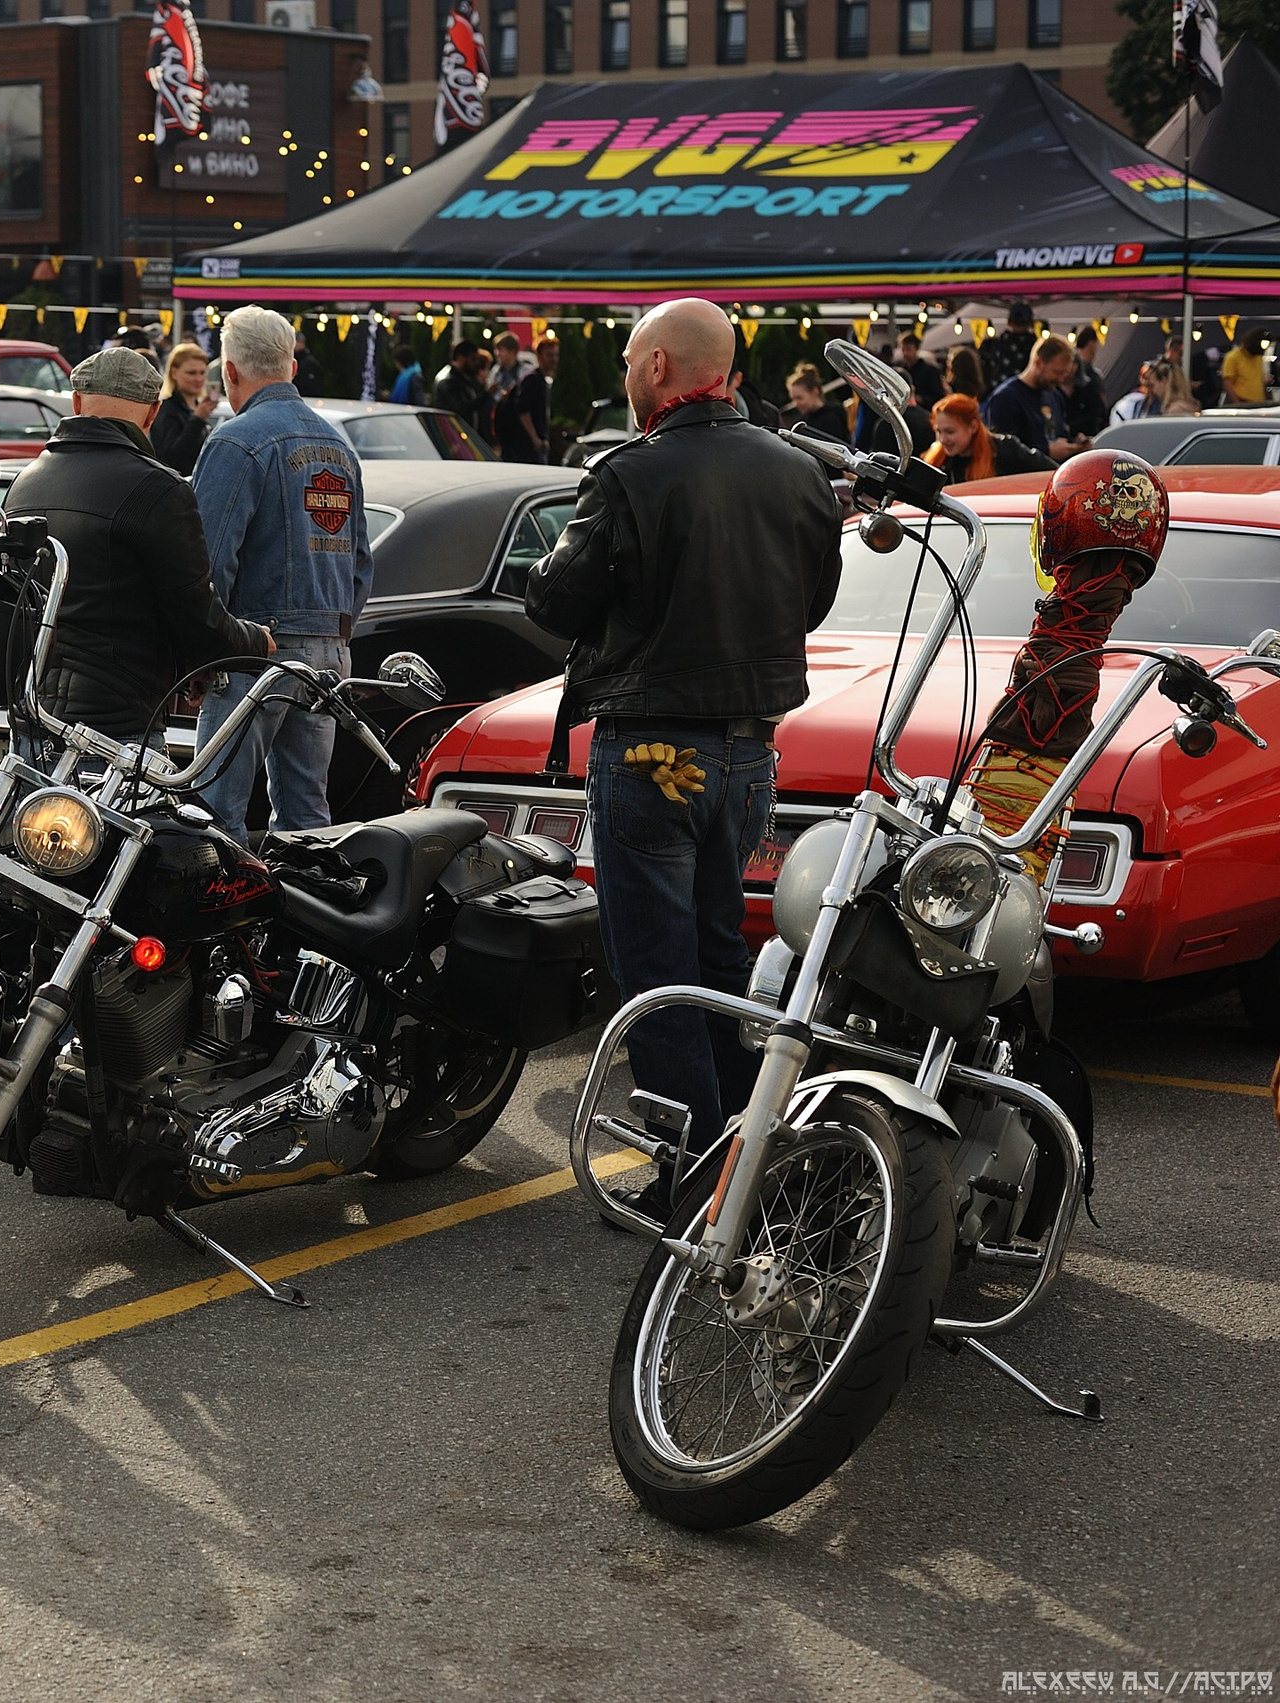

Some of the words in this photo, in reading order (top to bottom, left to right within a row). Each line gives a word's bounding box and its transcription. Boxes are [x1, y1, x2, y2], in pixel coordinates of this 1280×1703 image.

[484, 111, 784, 180] PVG
[437, 184, 911, 219] MOTORSPORT
[995, 244, 1116, 269] TIMONPVG
